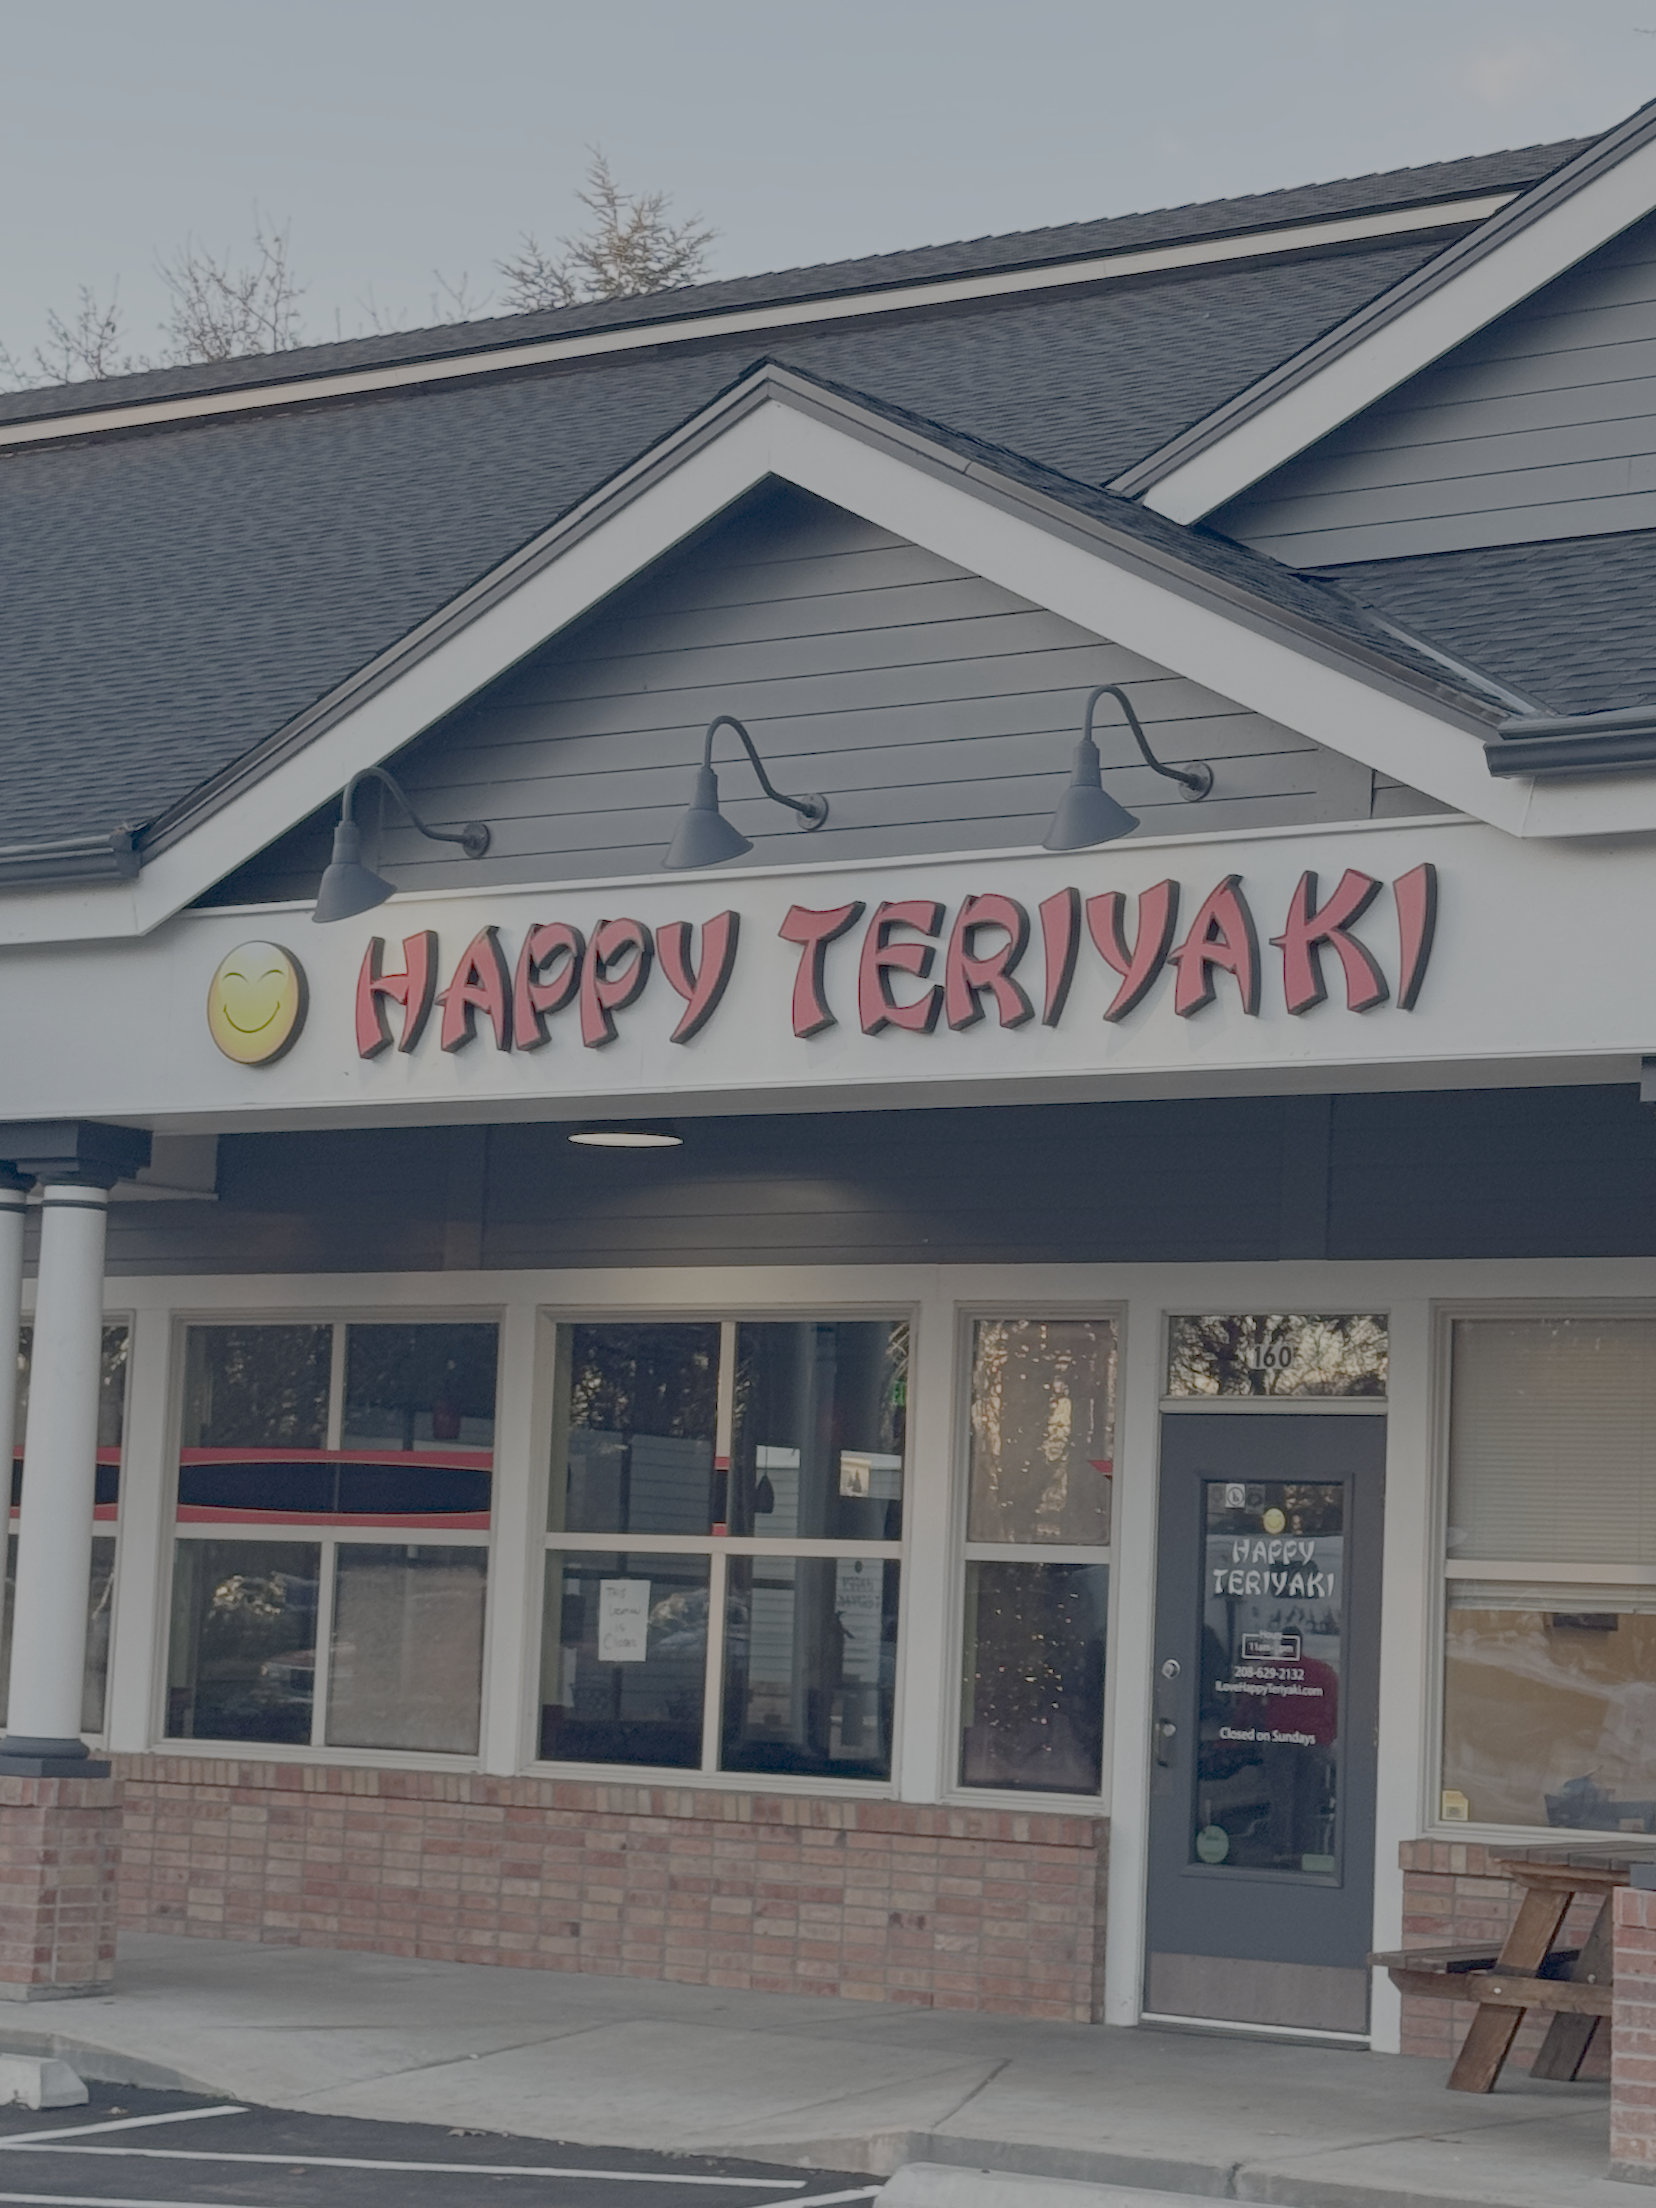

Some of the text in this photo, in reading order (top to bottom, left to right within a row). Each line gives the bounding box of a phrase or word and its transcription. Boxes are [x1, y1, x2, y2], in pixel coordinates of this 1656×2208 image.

[355, 862, 1438, 1060] HAPPY TERIYAKI
[1254, 1346, 1293, 1368] 160
[1232, 1538, 1315, 1566] HAPPY
[1212, 1568, 1335, 1598] TERIYAKI
[1234, 1666, 1304, 1680] 208-629-2132
[1220, 1727, 1316, 1746] Closed on Sundays
